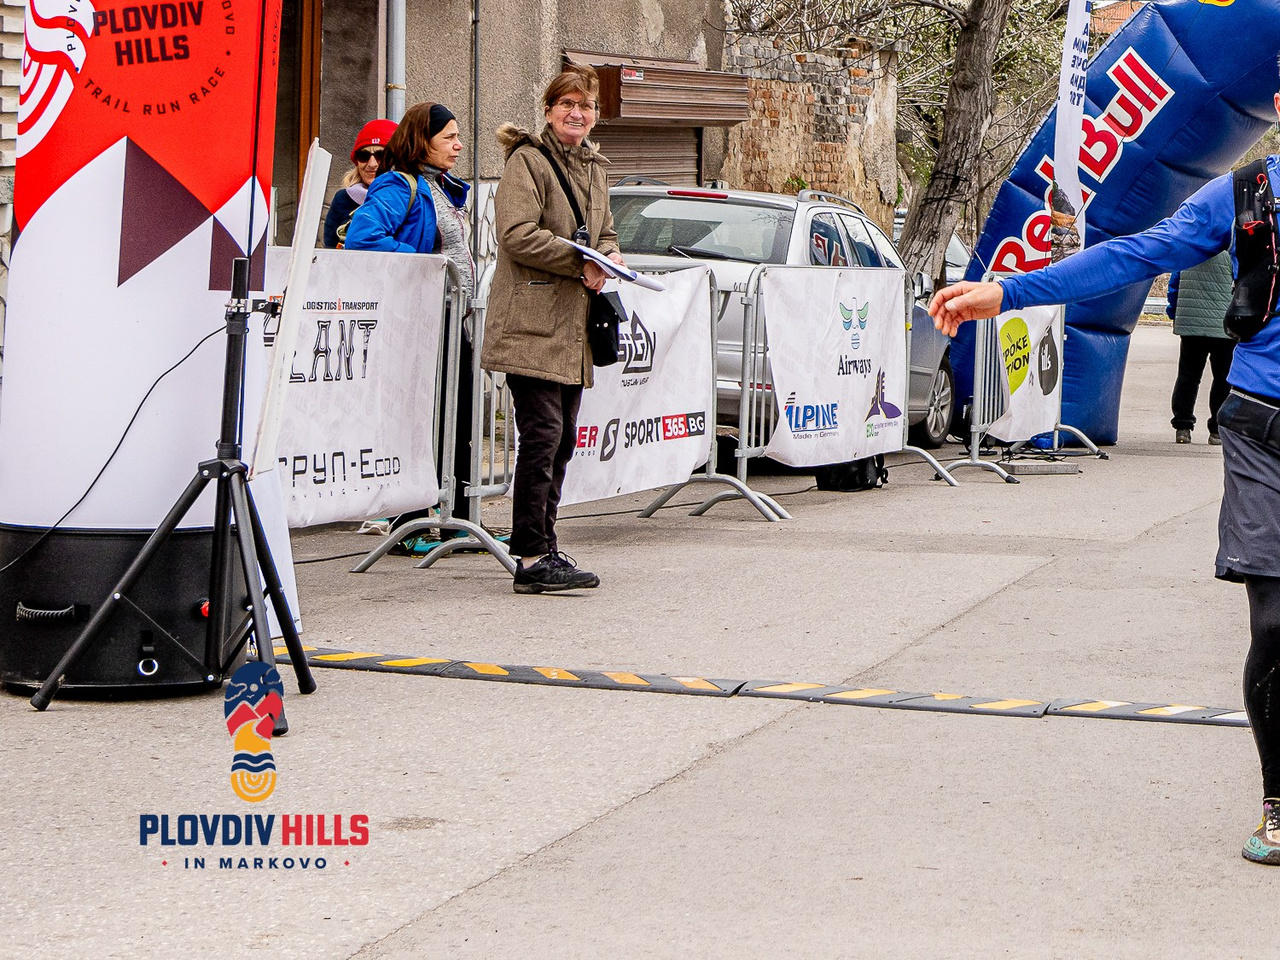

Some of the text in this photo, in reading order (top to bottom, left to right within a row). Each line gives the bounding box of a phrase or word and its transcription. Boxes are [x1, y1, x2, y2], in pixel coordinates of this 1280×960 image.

[92, 1, 204, 37] PLOVDIV
[114, 35, 190, 66] HILLS
[84, 67, 225, 115] TRAIL RUN RACE
[1077, 48, 1172, 180] Bull
[342, 301, 379, 311] TRANSPORT
[837, 354, 872, 379] Airways
[576, 426, 599, 448] ER
[624, 415, 705, 448] SPORT 365.BG
